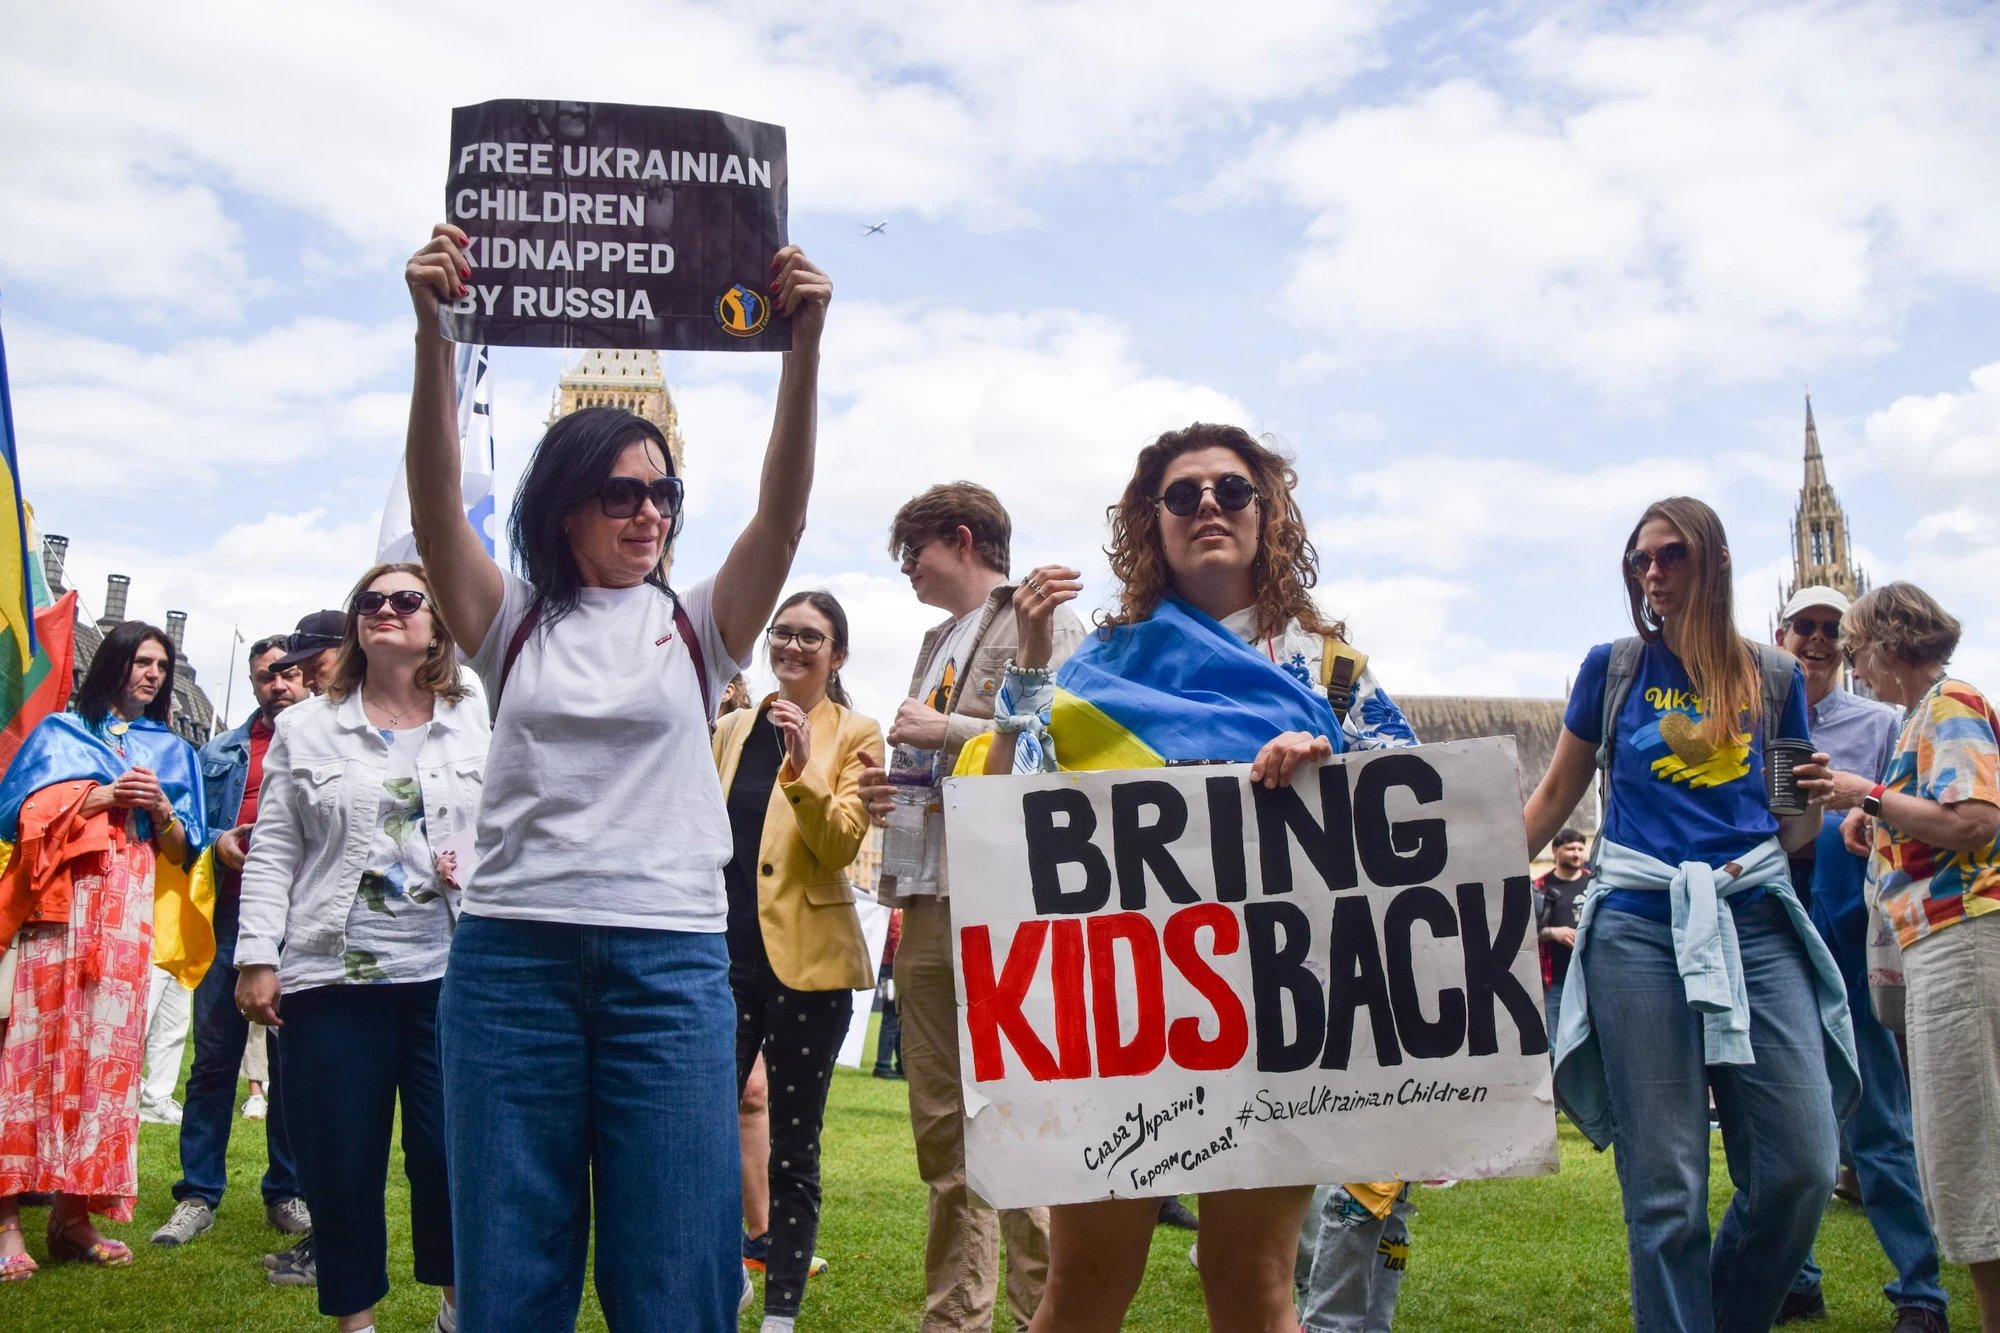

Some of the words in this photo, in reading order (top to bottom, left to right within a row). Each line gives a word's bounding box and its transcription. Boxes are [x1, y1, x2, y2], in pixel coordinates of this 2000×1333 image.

[458, 142, 553, 175] FREE
[564, 145, 771, 189] UKRAINIAN
[455, 188, 645, 226] CHILDREN
[453, 284, 503, 315] BY
[513, 286, 655, 320] RUSSIA
[1022, 755, 1447, 915] BRING
[960, 903, 1249, 1082] KIDS
[1243, 875, 1548, 1073] BACK
[1084, 1124, 1131, 1171] Слава
[1107, 1086, 1205, 1180] Україні!
[1131, 1152, 1180, 1190] Героям
[1181, 1126, 1238, 1171] Слава!
